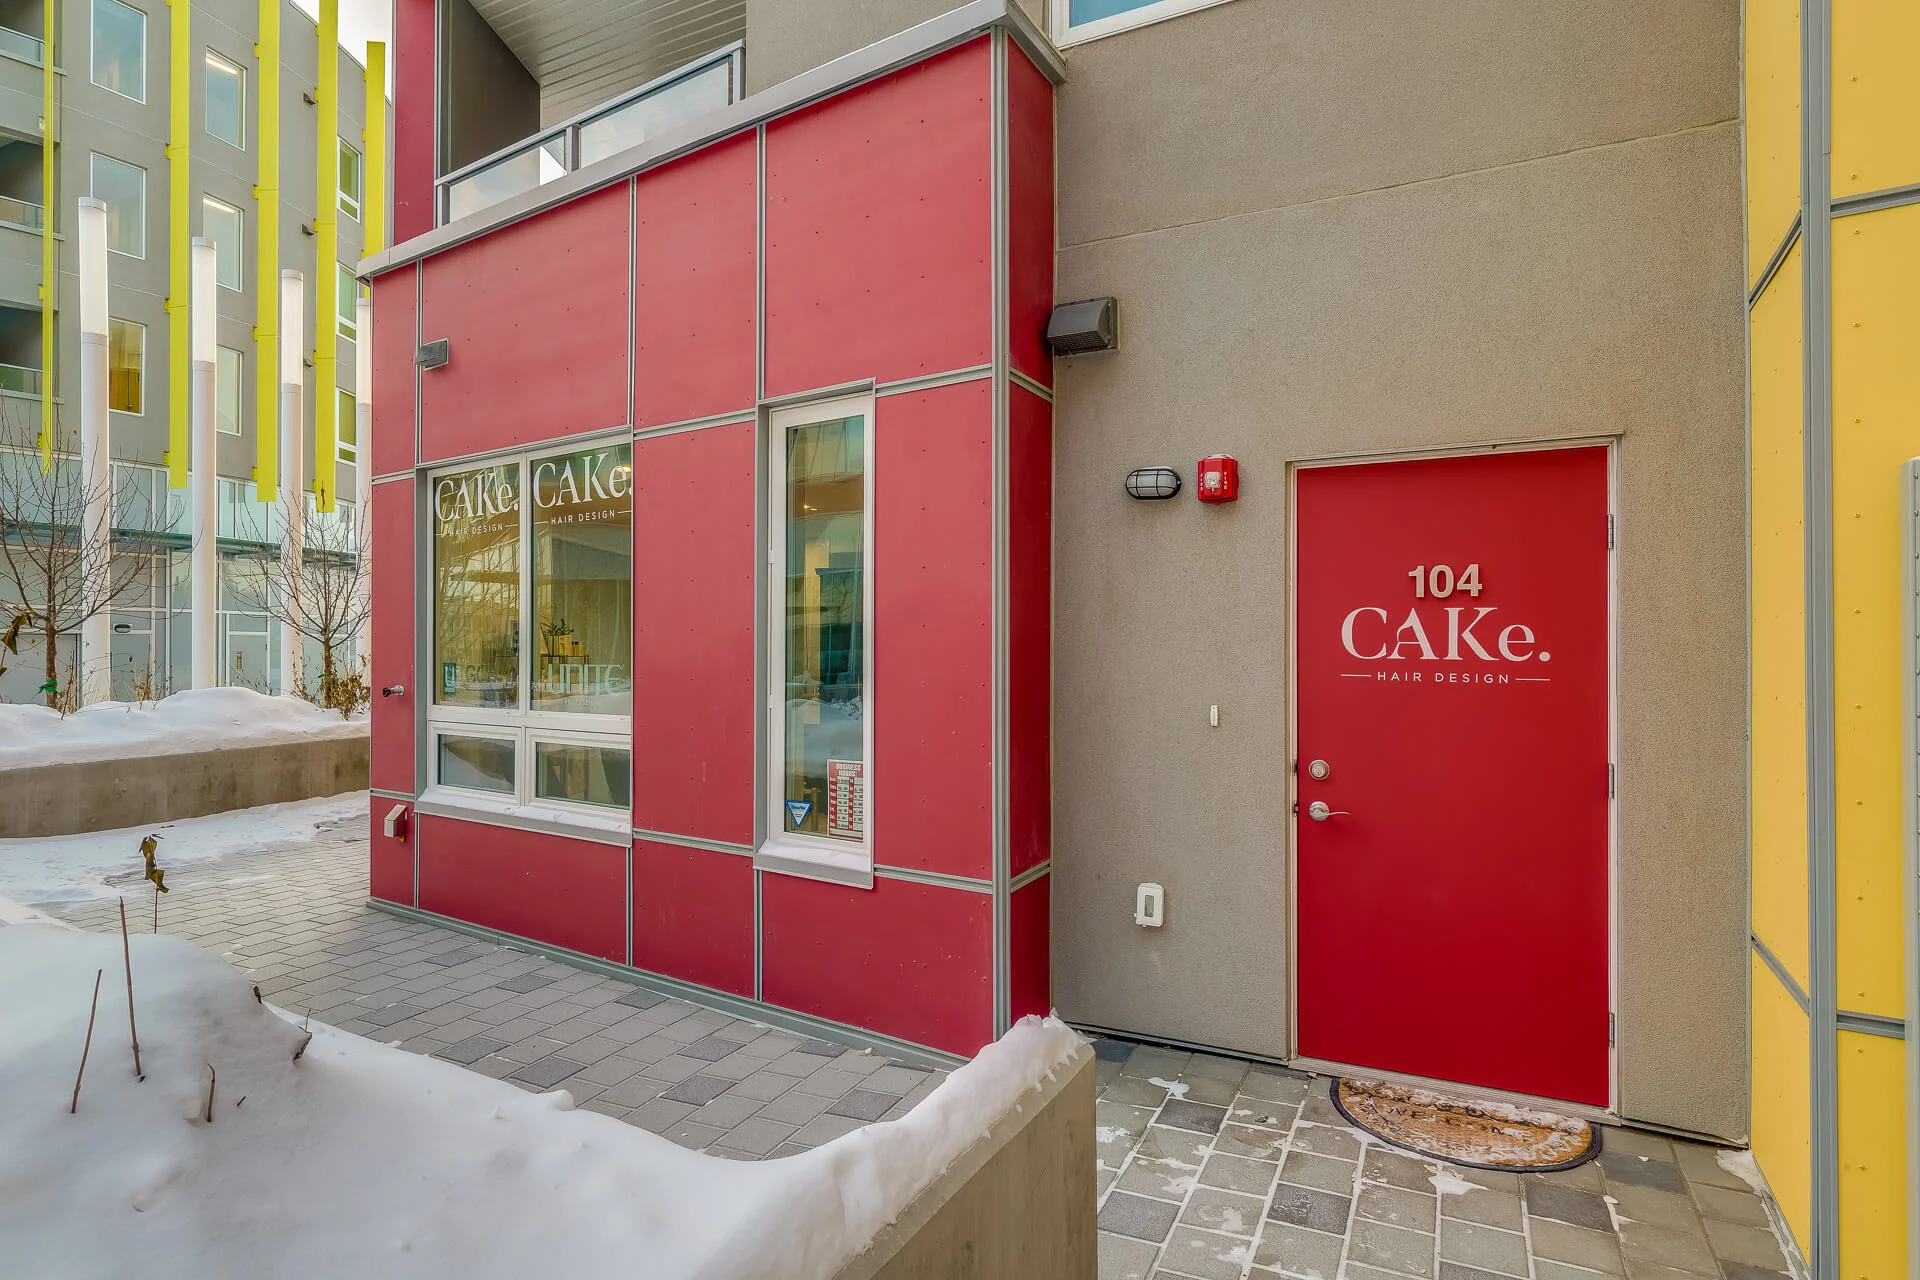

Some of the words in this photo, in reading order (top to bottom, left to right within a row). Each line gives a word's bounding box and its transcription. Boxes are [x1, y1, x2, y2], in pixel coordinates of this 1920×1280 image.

[435, 472, 519, 521] CAKe.
[449, 526, 469, 537] HAIR
[472, 523, 503, 535] DESIGN
[551, 514, 573, 525] HAIR
[578, 510, 615, 522] DESIGN
[1408, 563, 1483, 598] 104
[1341, 606, 1551, 662] CAKe.
[1377, 671, 1422, 682] HAIR
[1434, 672, 1509, 684] DESIGN
